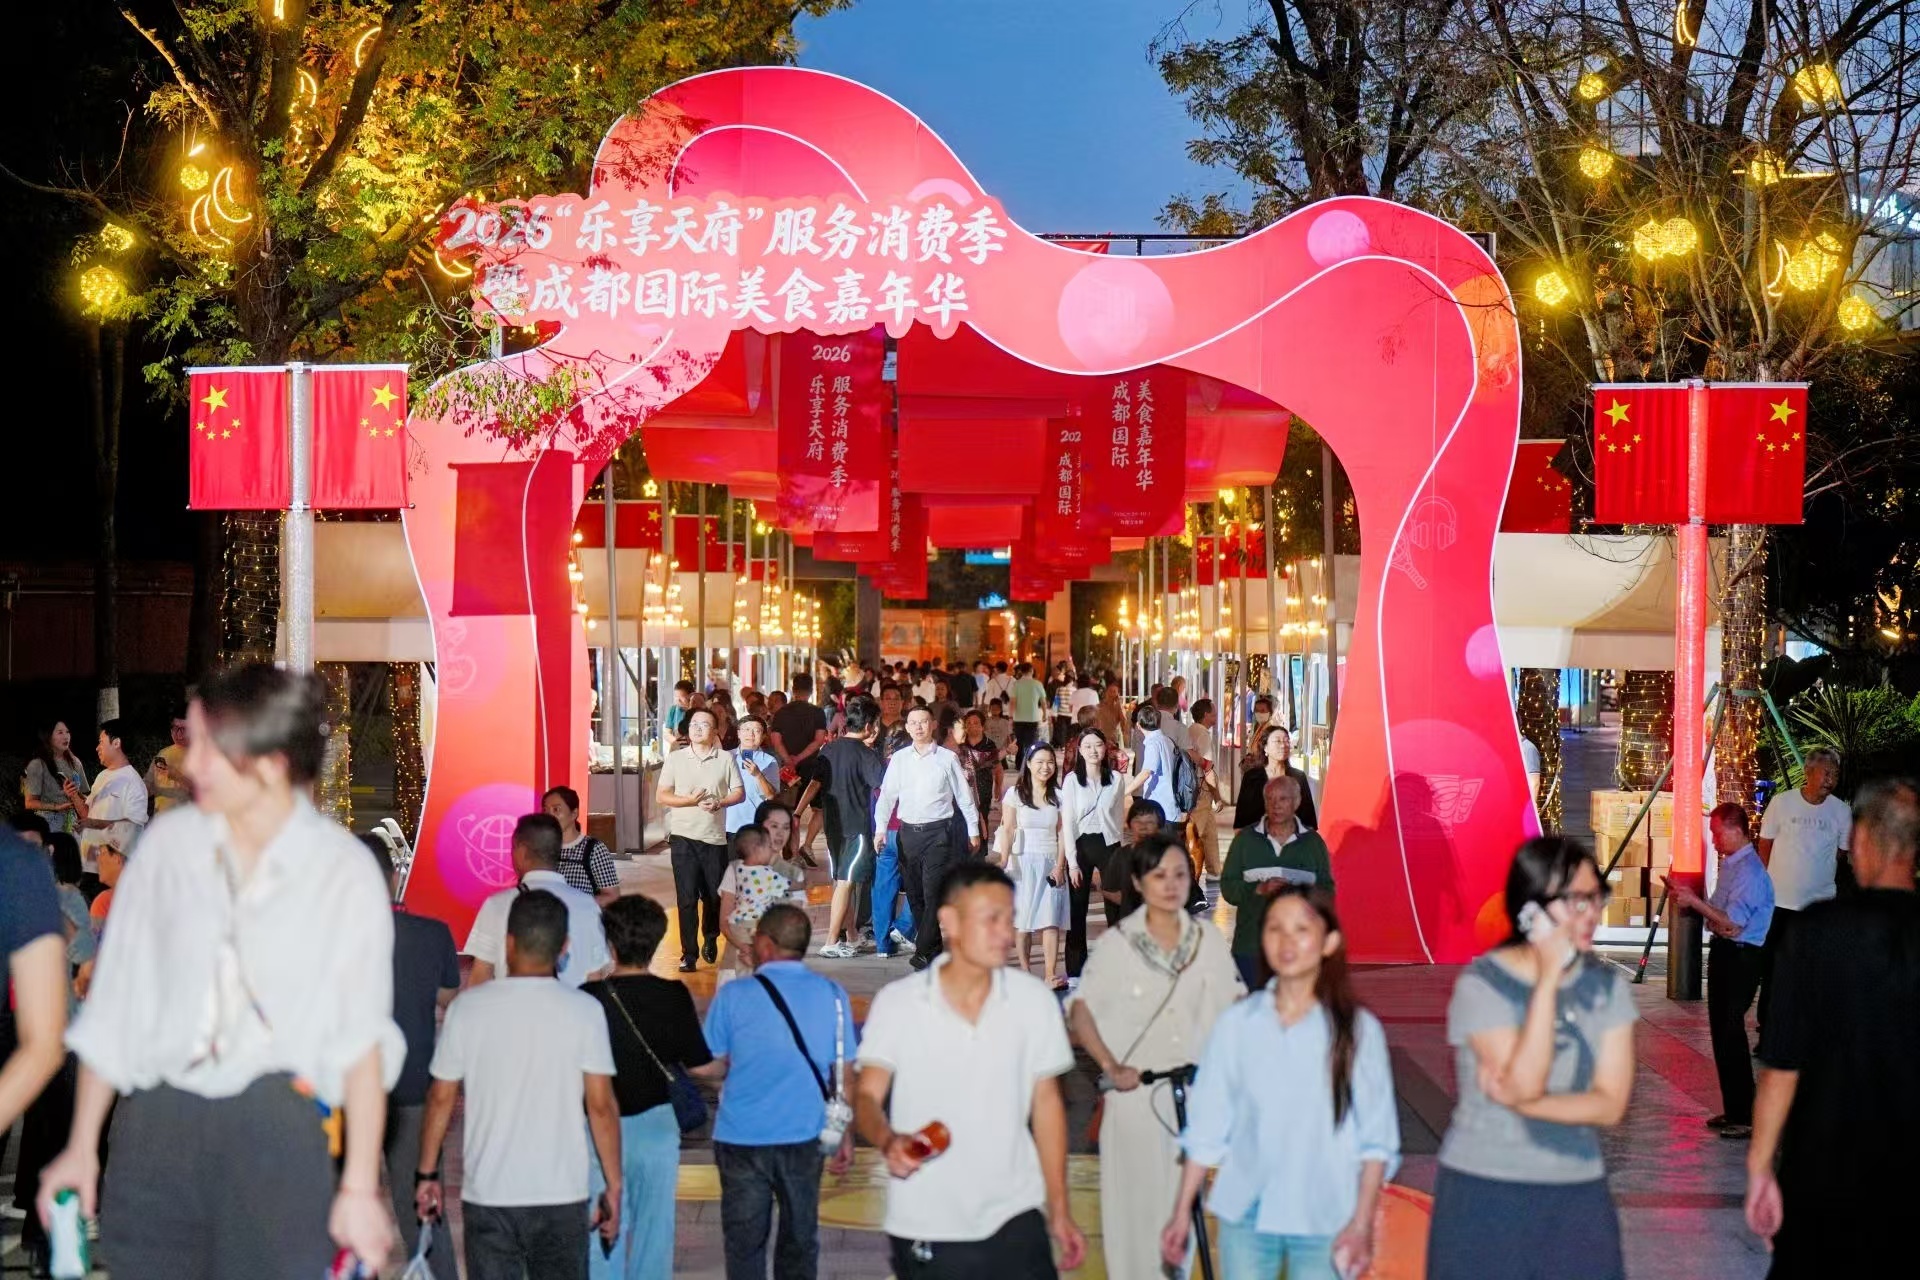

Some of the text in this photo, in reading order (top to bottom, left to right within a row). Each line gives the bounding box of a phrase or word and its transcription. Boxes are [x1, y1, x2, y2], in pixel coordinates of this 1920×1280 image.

[481, 263, 969, 328] 暨成都国际美食嘉年华
[812, 345, 851, 362] 2026
[806, 374, 826, 461] 乐享天府
[830, 375, 853, 488] 服务消费季
[1060, 430, 1081, 443] 202
[1111, 380, 1131, 468] 成都国际
[1135, 379, 1154, 491] 美食嘉年华
[1057, 452, 1073, 516] 成都国际
